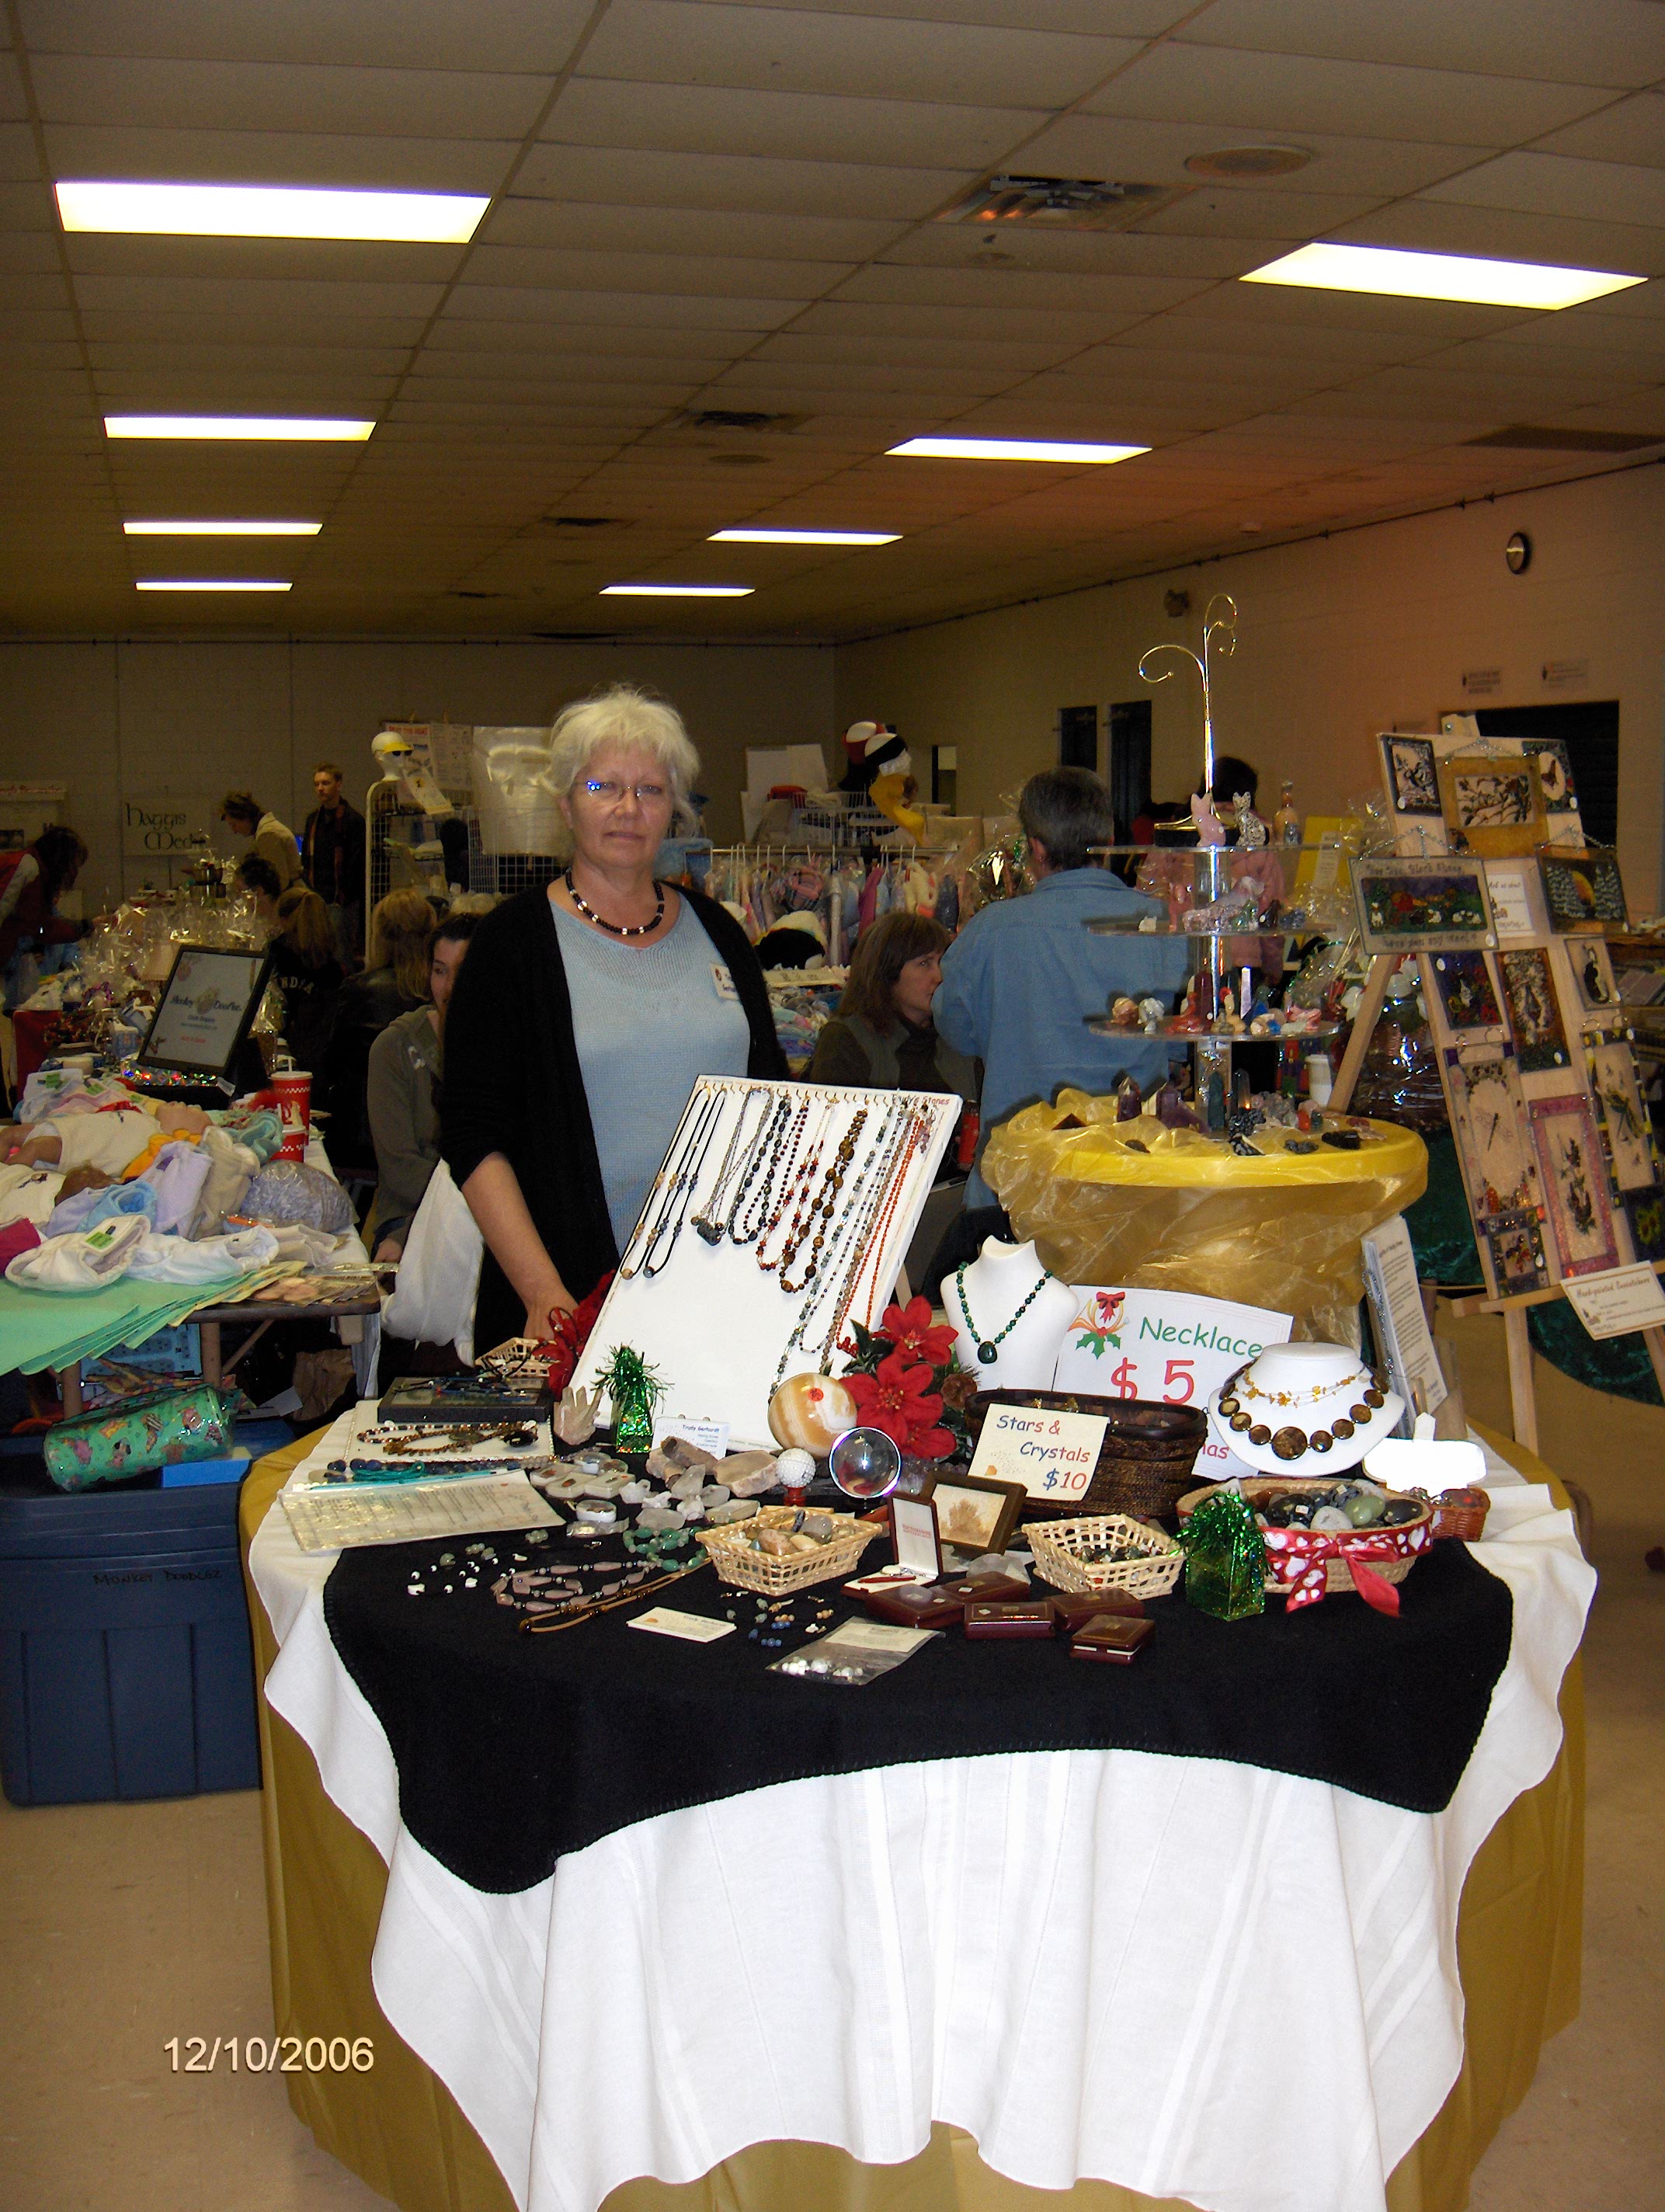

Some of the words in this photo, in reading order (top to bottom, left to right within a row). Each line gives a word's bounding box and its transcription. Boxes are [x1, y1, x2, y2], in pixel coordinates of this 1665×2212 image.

[1163, 1360, 1194, 1404] 5
[996, 1415, 1045, 1433] Stars
[1048, 1420, 1061, 1435] &
[1020, 1442, 1091, 1462] Crystals
[1042, 1467, 1088, 1492] $10
